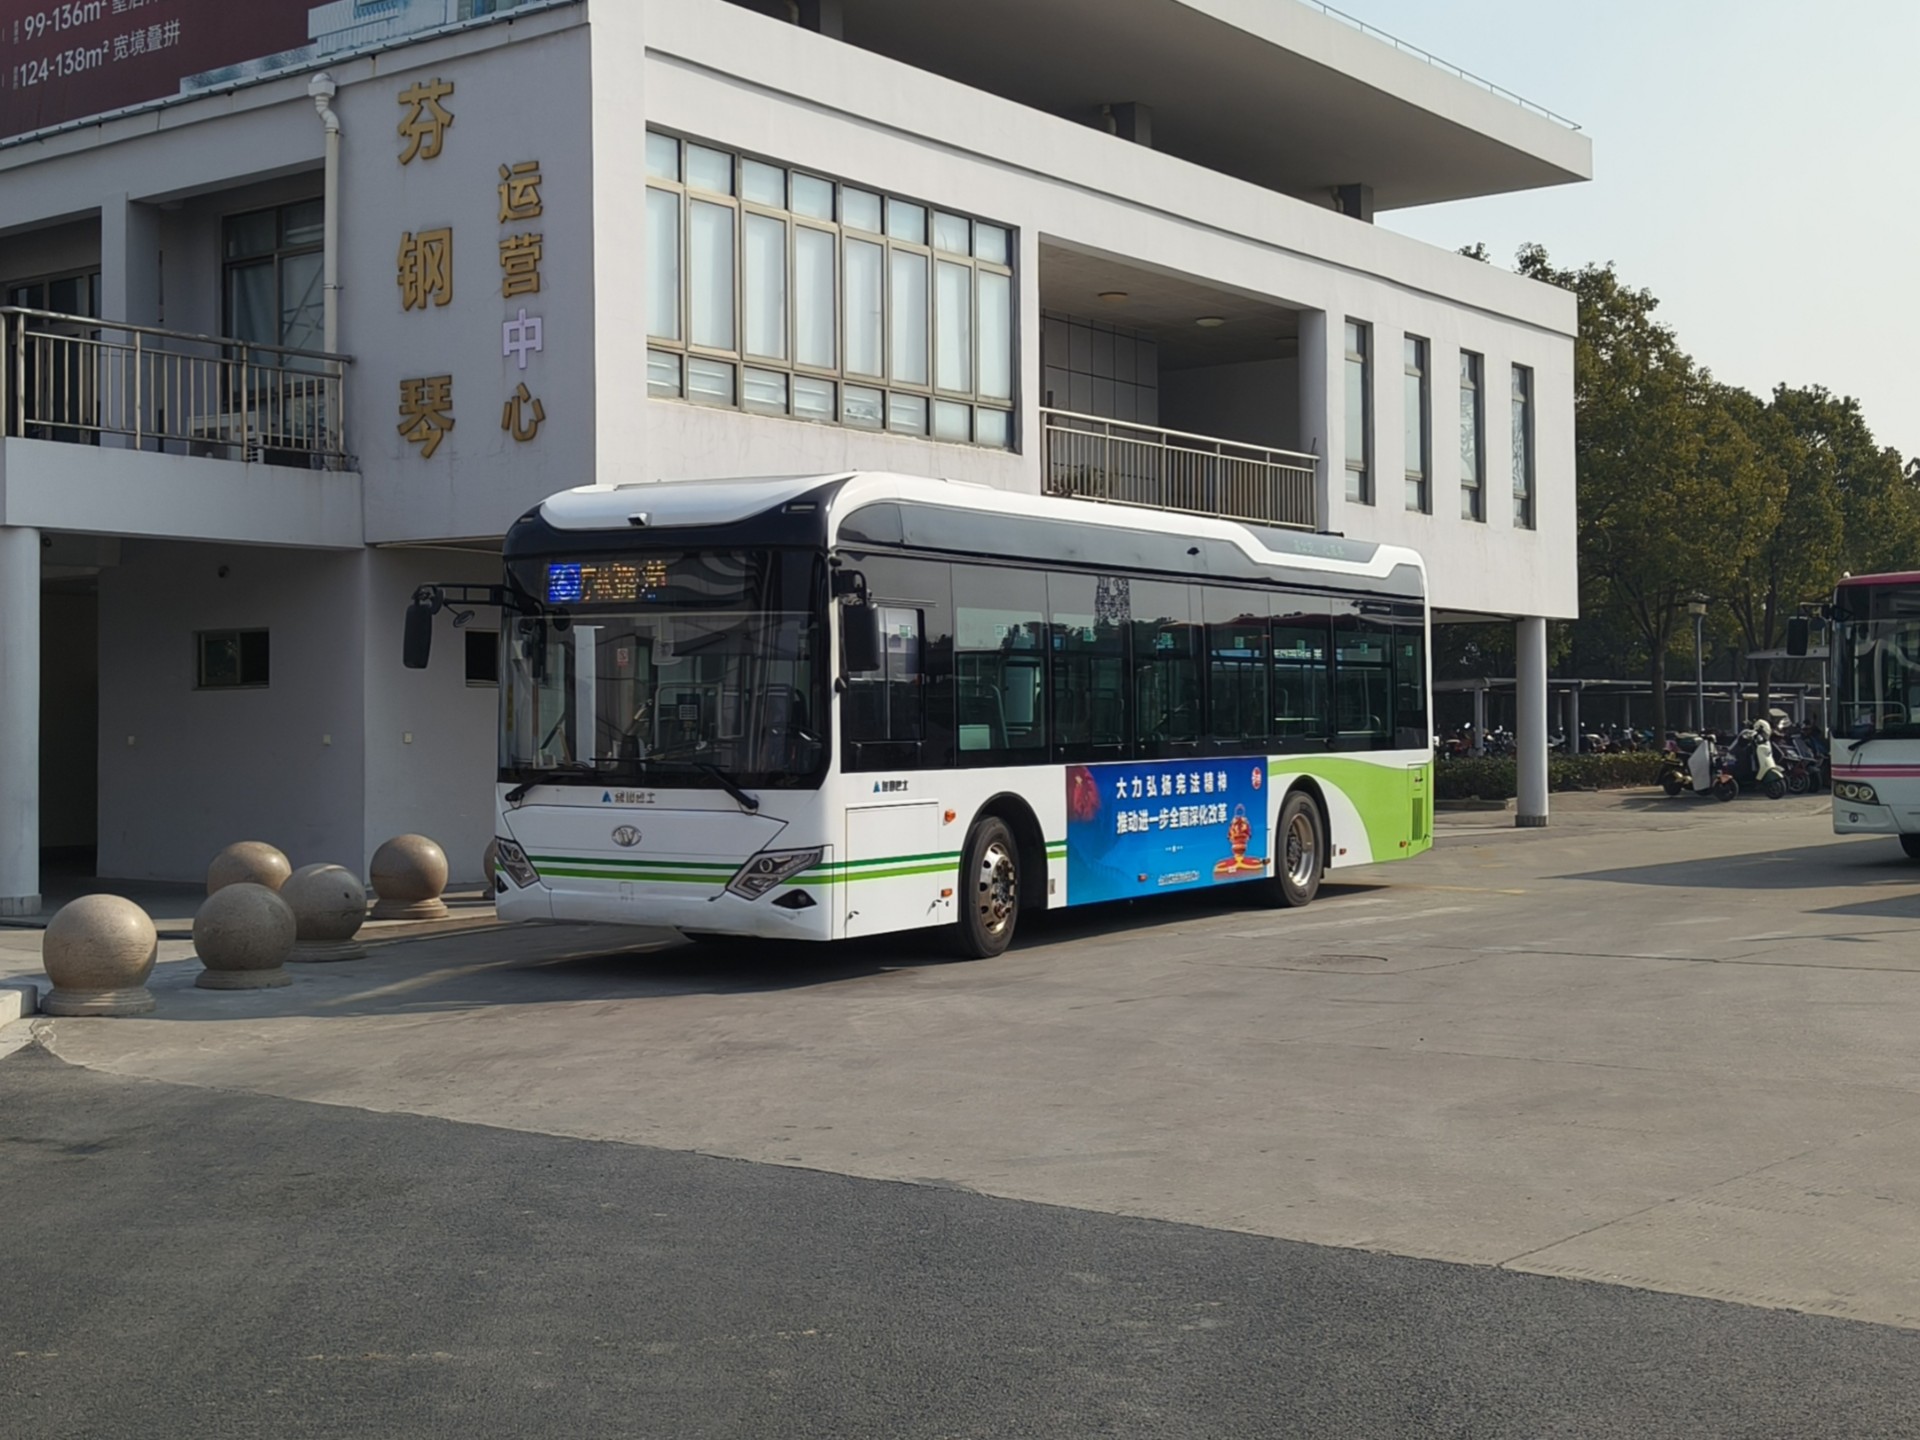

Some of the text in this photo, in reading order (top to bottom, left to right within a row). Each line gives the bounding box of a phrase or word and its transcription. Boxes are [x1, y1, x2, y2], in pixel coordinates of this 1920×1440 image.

[113, 19, 181, 61] 宽境叠拼
[397, 77, 455, 460] 芬钢琴
[498, 160, 546, 442] 运营中心
[1115, 770, 1228, 799] 大力弘扬宪法精神
[1116, 802, 1228, 834] 推动进一步全面深化改革
